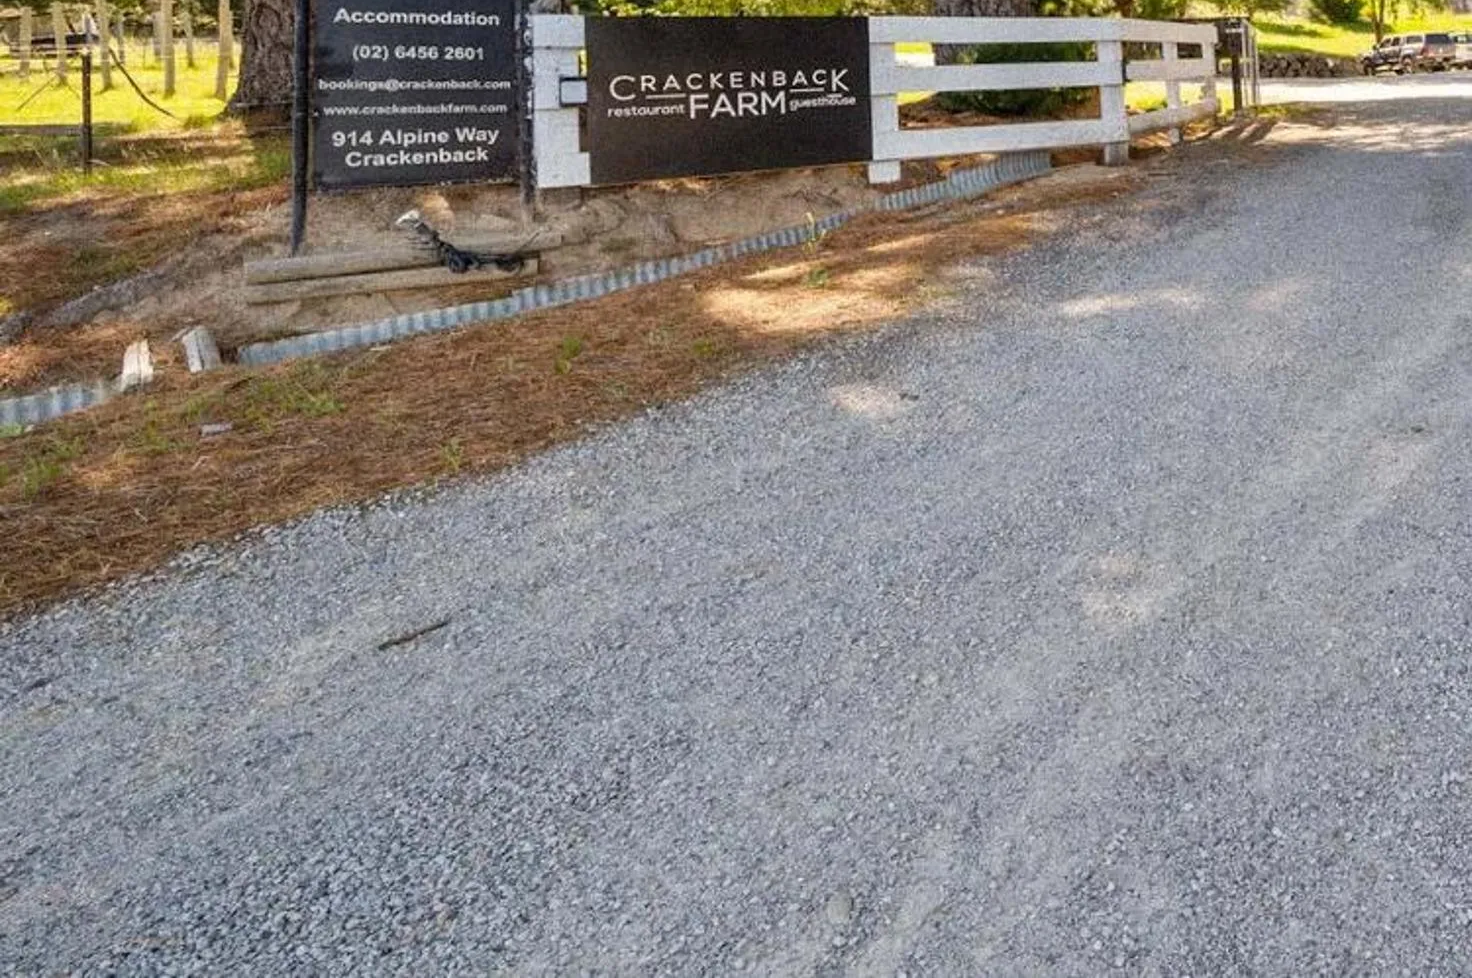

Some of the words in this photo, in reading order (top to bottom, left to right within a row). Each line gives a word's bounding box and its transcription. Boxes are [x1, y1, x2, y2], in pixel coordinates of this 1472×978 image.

[333, 8, 500, 26] Accommodation
[352, 45, 389, 61] (02)
[395, 46, 438, 60] 6456
[445, 47, 484, 61] 2601
[609, 68, 849, 101] CRACKENBACK
[323, 103, 508, 116] www.crackenbackfarm.com
[607, 103, 685, 118] restaurant
[689, 90, 786, 119] FARM
[788, 94, 857, 111] guesthouse
[332, 130, 374, 148] 914
[379, 128, 449, 148] Alpine
[455, 126, 500, 144] Way
[345, 147, 489, 167] Crackenback
